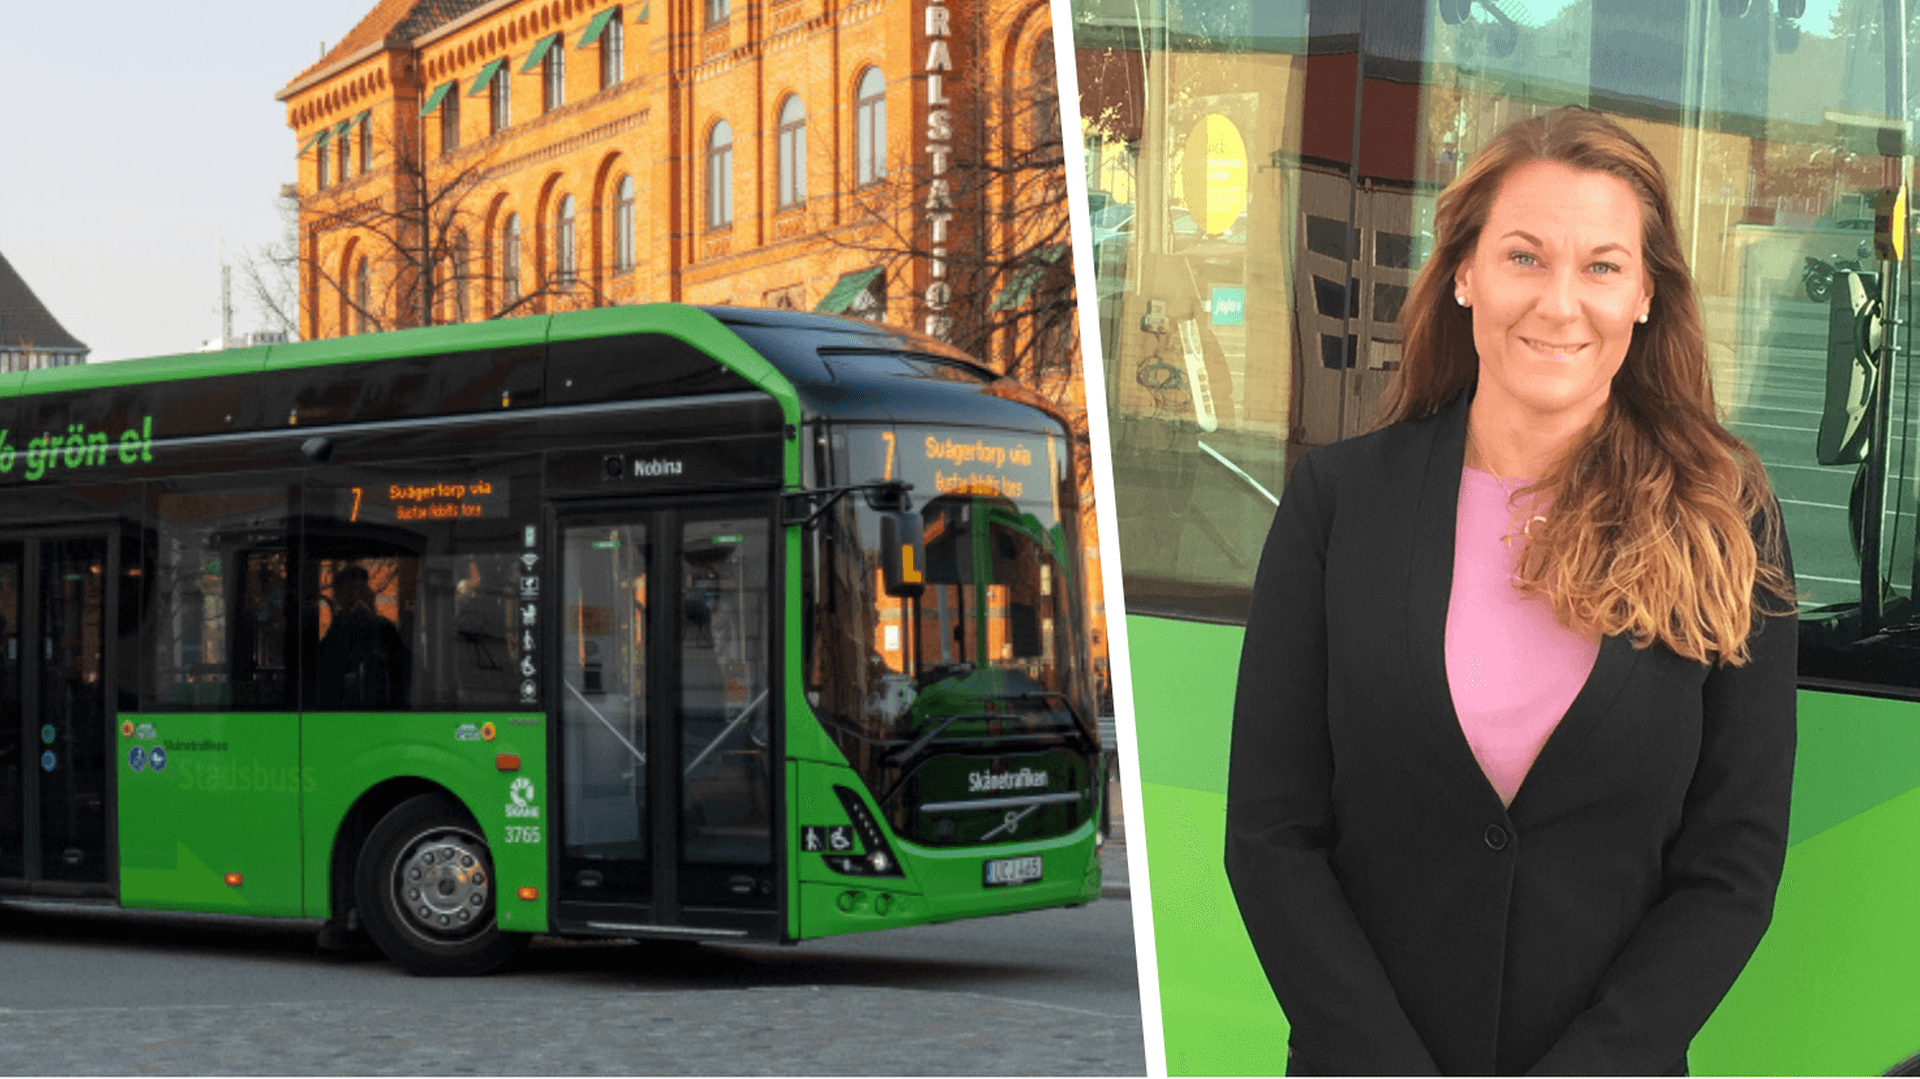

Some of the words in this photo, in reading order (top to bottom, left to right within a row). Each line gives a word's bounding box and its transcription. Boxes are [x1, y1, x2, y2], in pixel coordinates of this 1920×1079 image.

[925, 0, 952, 343] RALSTATION
[24, 423, 108, 481] grön
[118, 415, 153, 464] el
[634, 458, 682, 477] Nobina
[880, 432, 896, 481] 7
[1009, 443, 1032, 466] via
[351, 487, 362, 522] 7
[469, 480, 492, 495] via
[180, 757, 316, 793] Stadsbuss
[968, 767, 1048, 792] Skånetrafiken
[505, 826, 540, 843] 3765
